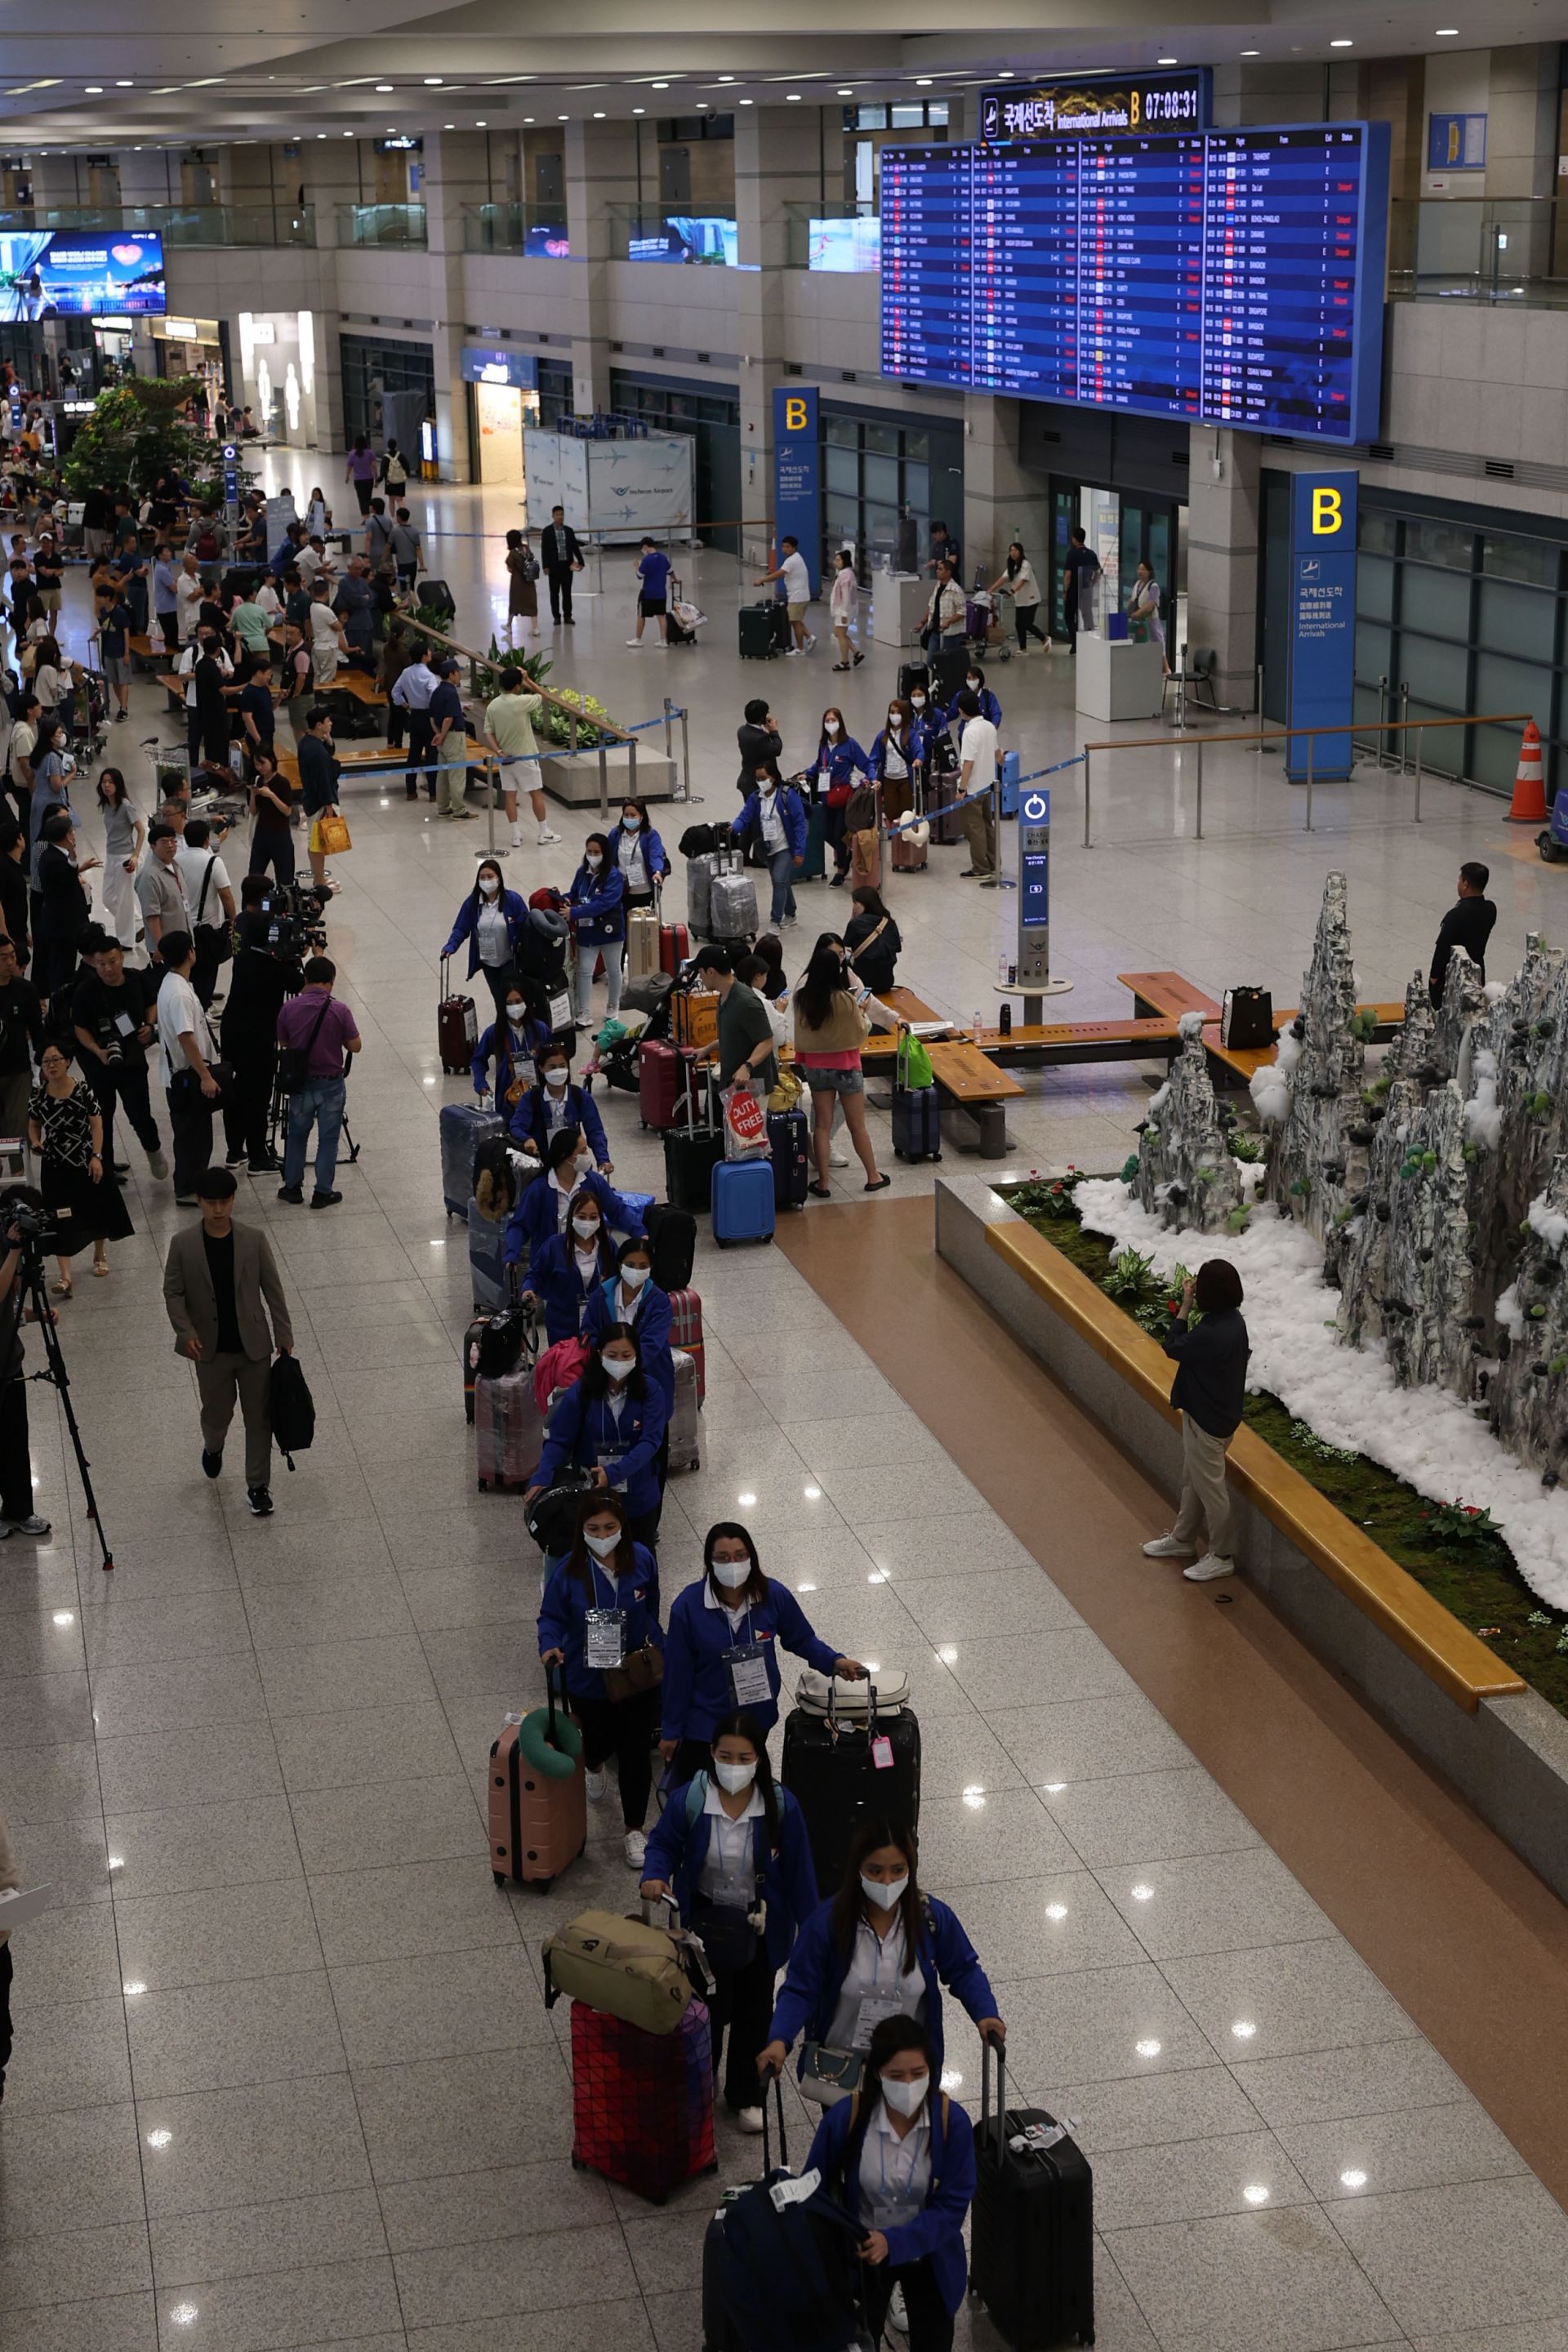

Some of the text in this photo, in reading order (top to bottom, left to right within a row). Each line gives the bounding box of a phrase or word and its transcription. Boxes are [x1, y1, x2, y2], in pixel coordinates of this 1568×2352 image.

[1131, 91, 1140, 124] B
[1145, 90, 1197, 120] 07:08:31
[1004, 100, 1055, 133] 국제선도착
[1057, 109, 1127, 129] International Arrivals
[786, 399, 807, 430] B
[1312, 488, 1343, 535] B
[1300, 587, 1343, 598] 국제선도착
[1298, 629, 1325, 638] Arrivals
[1299, 621, 1345, 630] International
[733, 1098, 755, 1119] DUTY
[737, 1112, 763, 1134] FREE
